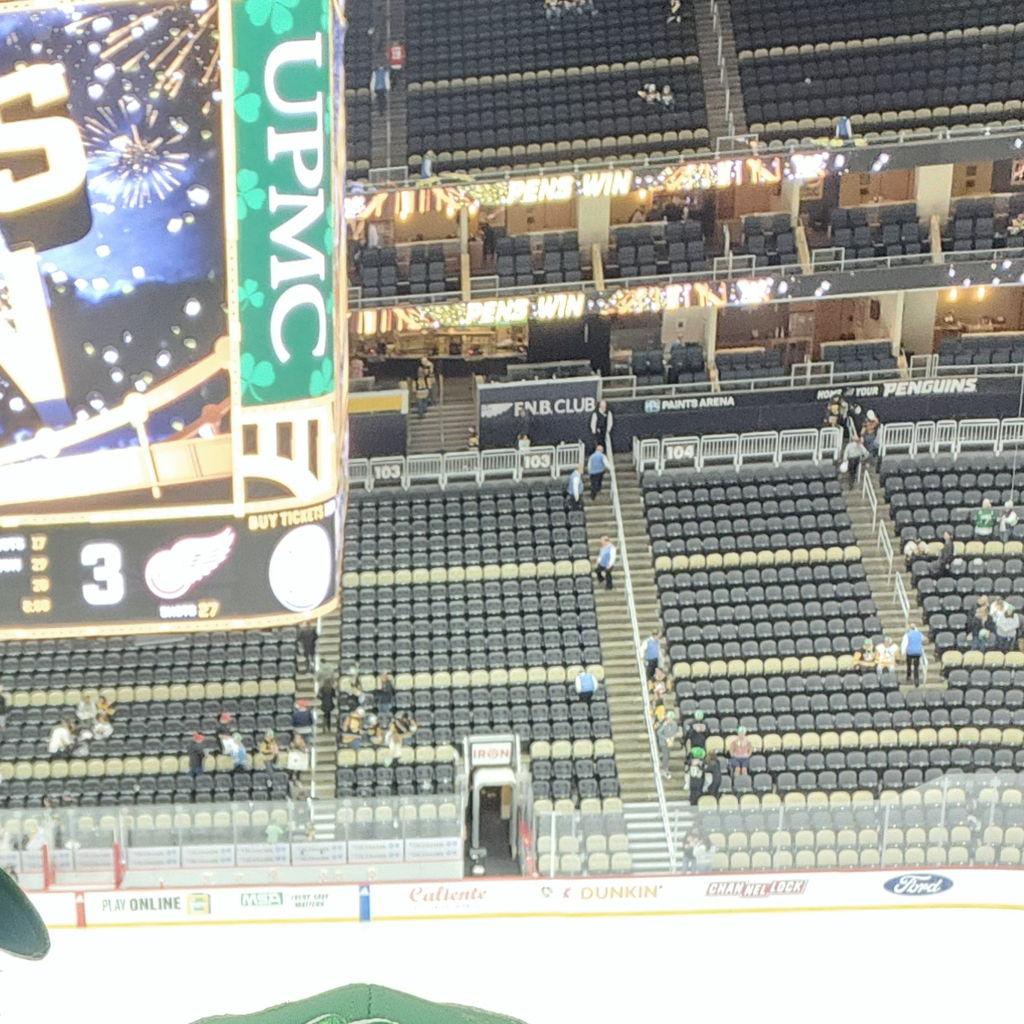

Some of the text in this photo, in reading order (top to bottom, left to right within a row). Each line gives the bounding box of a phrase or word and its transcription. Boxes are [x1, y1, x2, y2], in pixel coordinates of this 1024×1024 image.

[507, 169, 633, 205] PENS WIN
[263, 32, 328, 365] UPMC
[464, 292, 586, 325] PENS WIN
[856, 386, 879, 397] YOUR
[883, 378, 978, 398] PENGUINS
[554, 397, 596, 414] CLUB
[662, 399, 698, 410] PAINTS
[699, 396, 735, 408] ARENA
[666, 445, 694, 460] 104
[524, 454, 551, 469] 103
[374, 465, 401, 479] 103
[248, 512, 279, 531] BUY
[279, 504, 324, 527] TICKETS
[80, 542, 125, 606] 3
[580, 884, 664, 900] DUNKIN'
[894, 874, 943, 896] Ford
[409, 886, 487, 903] Caliente
[102, 898, 126, 913] PLAY
[129, 896, 182, 912] ONLINE
